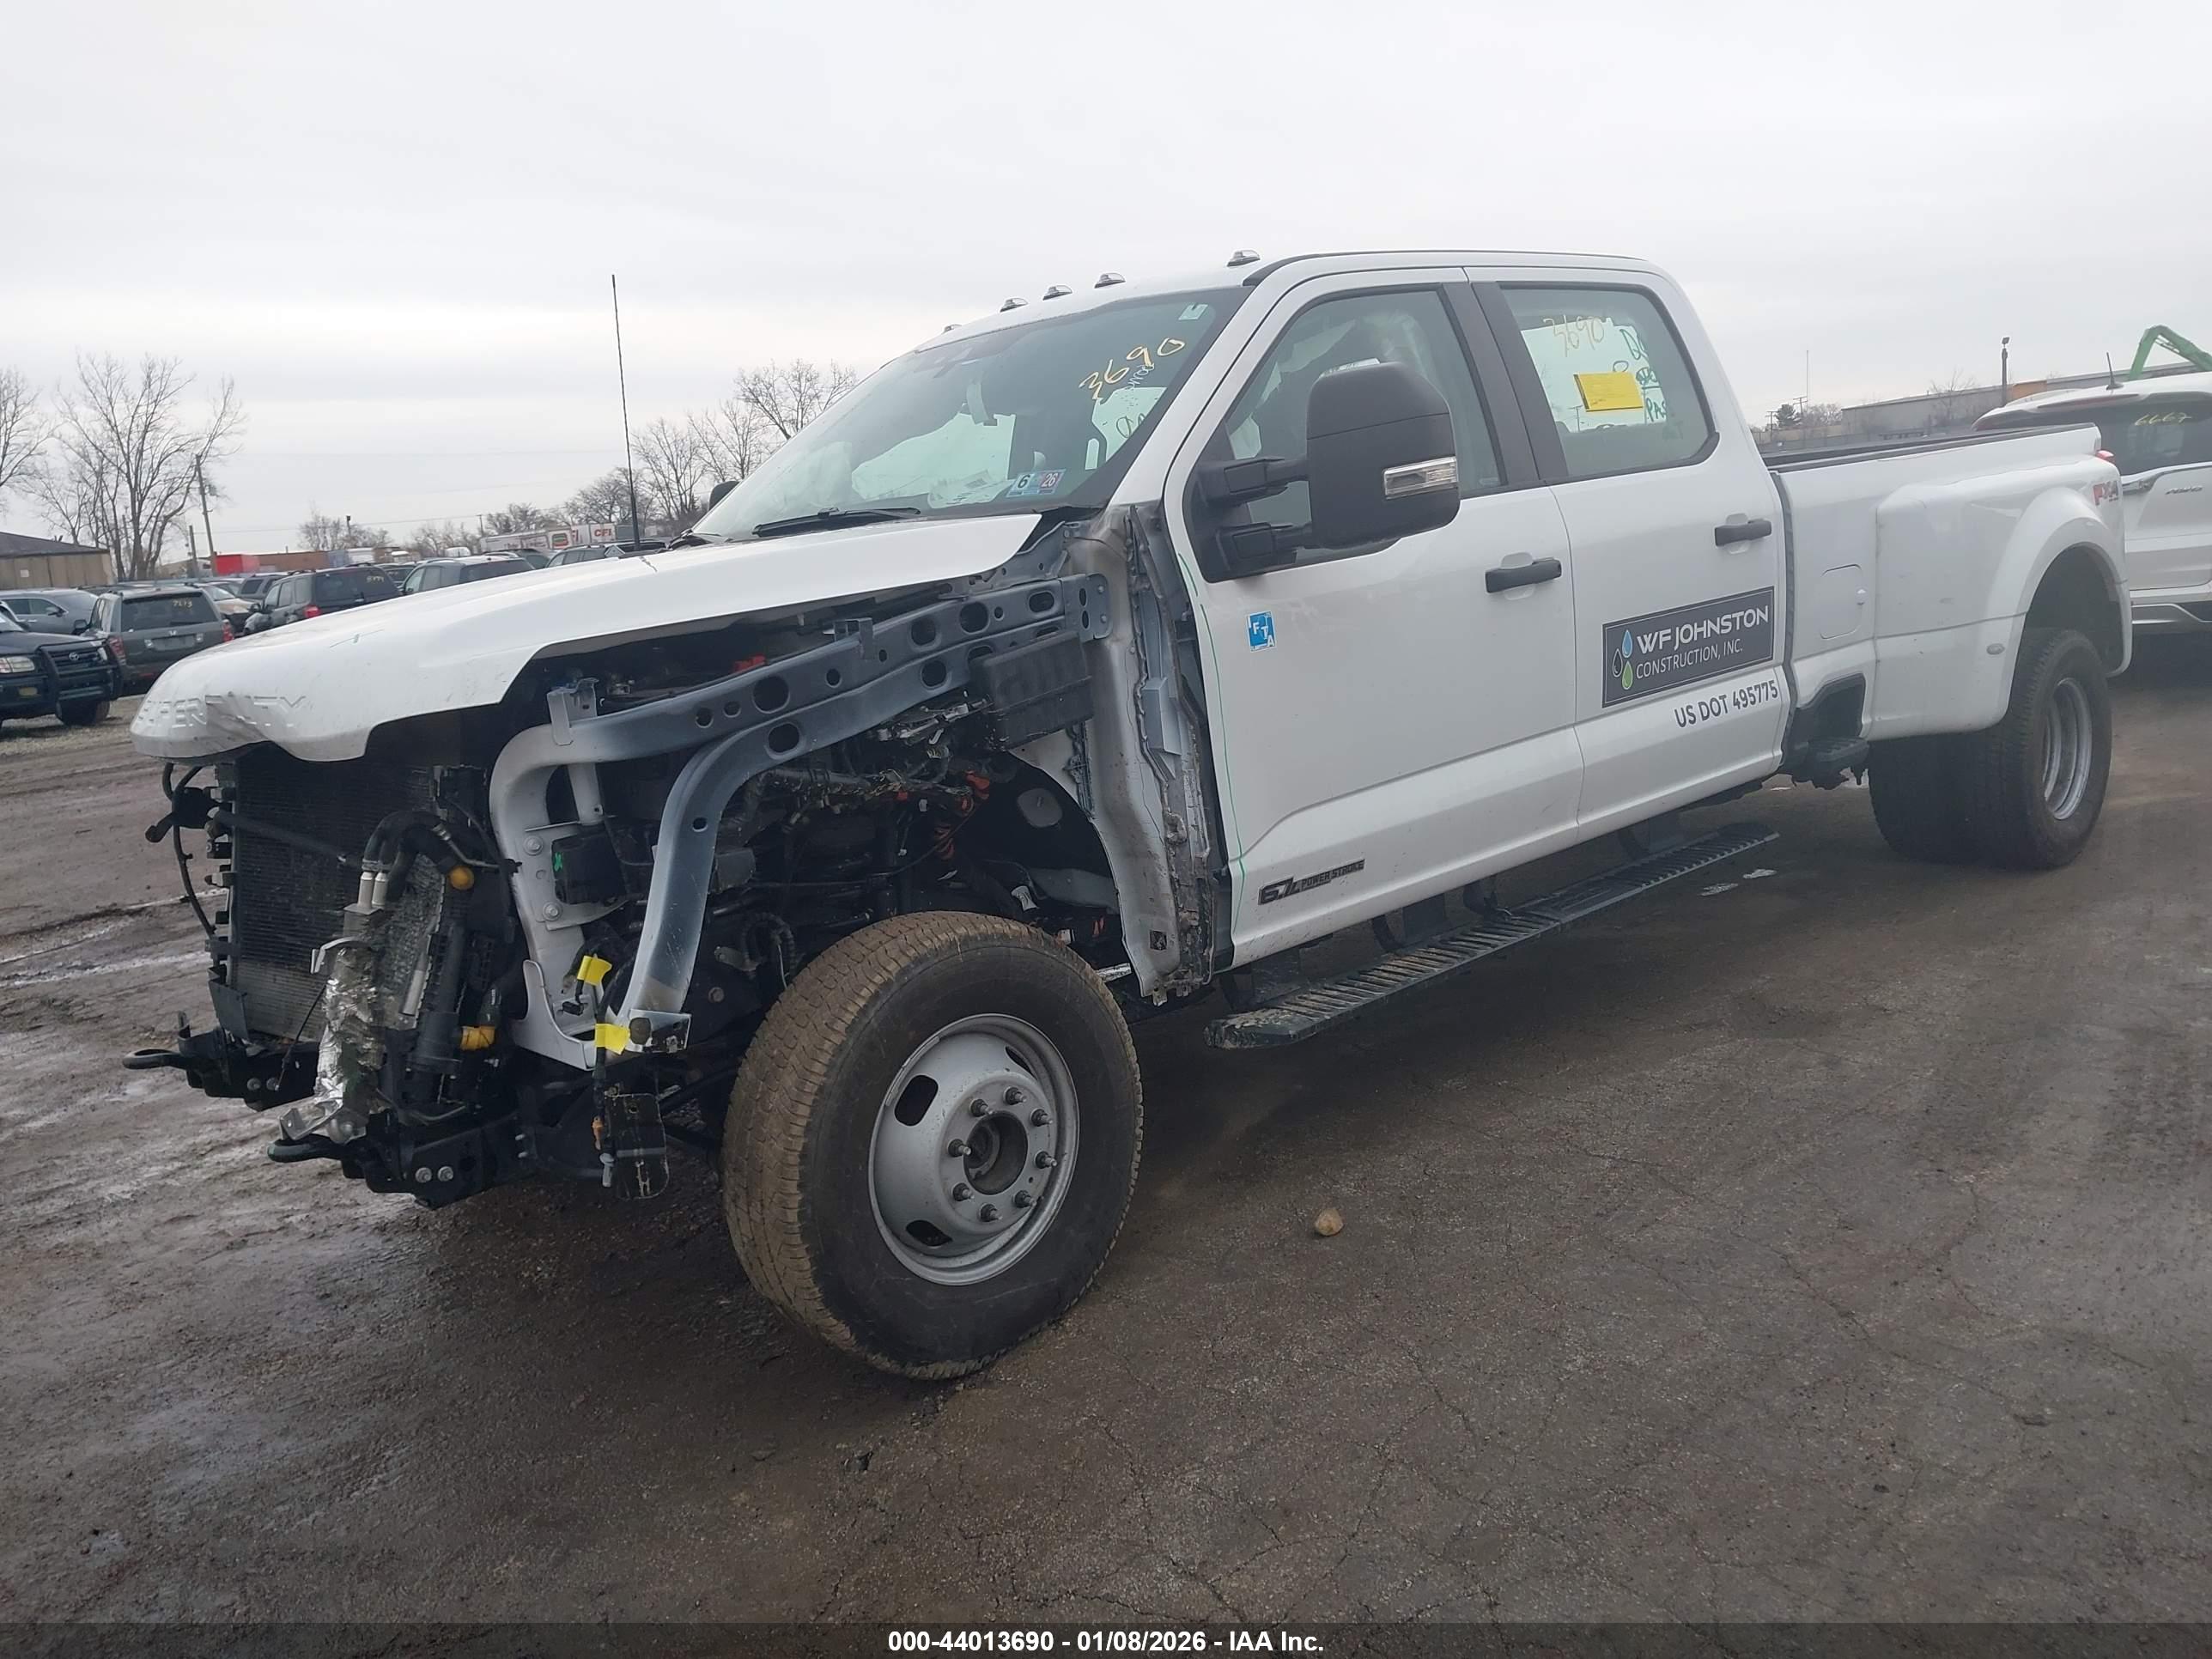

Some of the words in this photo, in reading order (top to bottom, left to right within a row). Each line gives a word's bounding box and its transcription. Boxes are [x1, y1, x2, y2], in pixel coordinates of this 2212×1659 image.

[1078, 337, 1186, 400] 3690
[1017, 475, 1031, 489] 6
[1637, 628, 1672, 654] WF
[1674, 605, 1769, 652] JOHNSTON
[1636, 644, 1721, 679] CONSTRUCTION,
[1723, 638, 1743, 657] INC.
[1674, 703, 1697, 728] US
[1698, 694, 1729, 721] DOT
[1733, 679, 1778, 710] 495775
